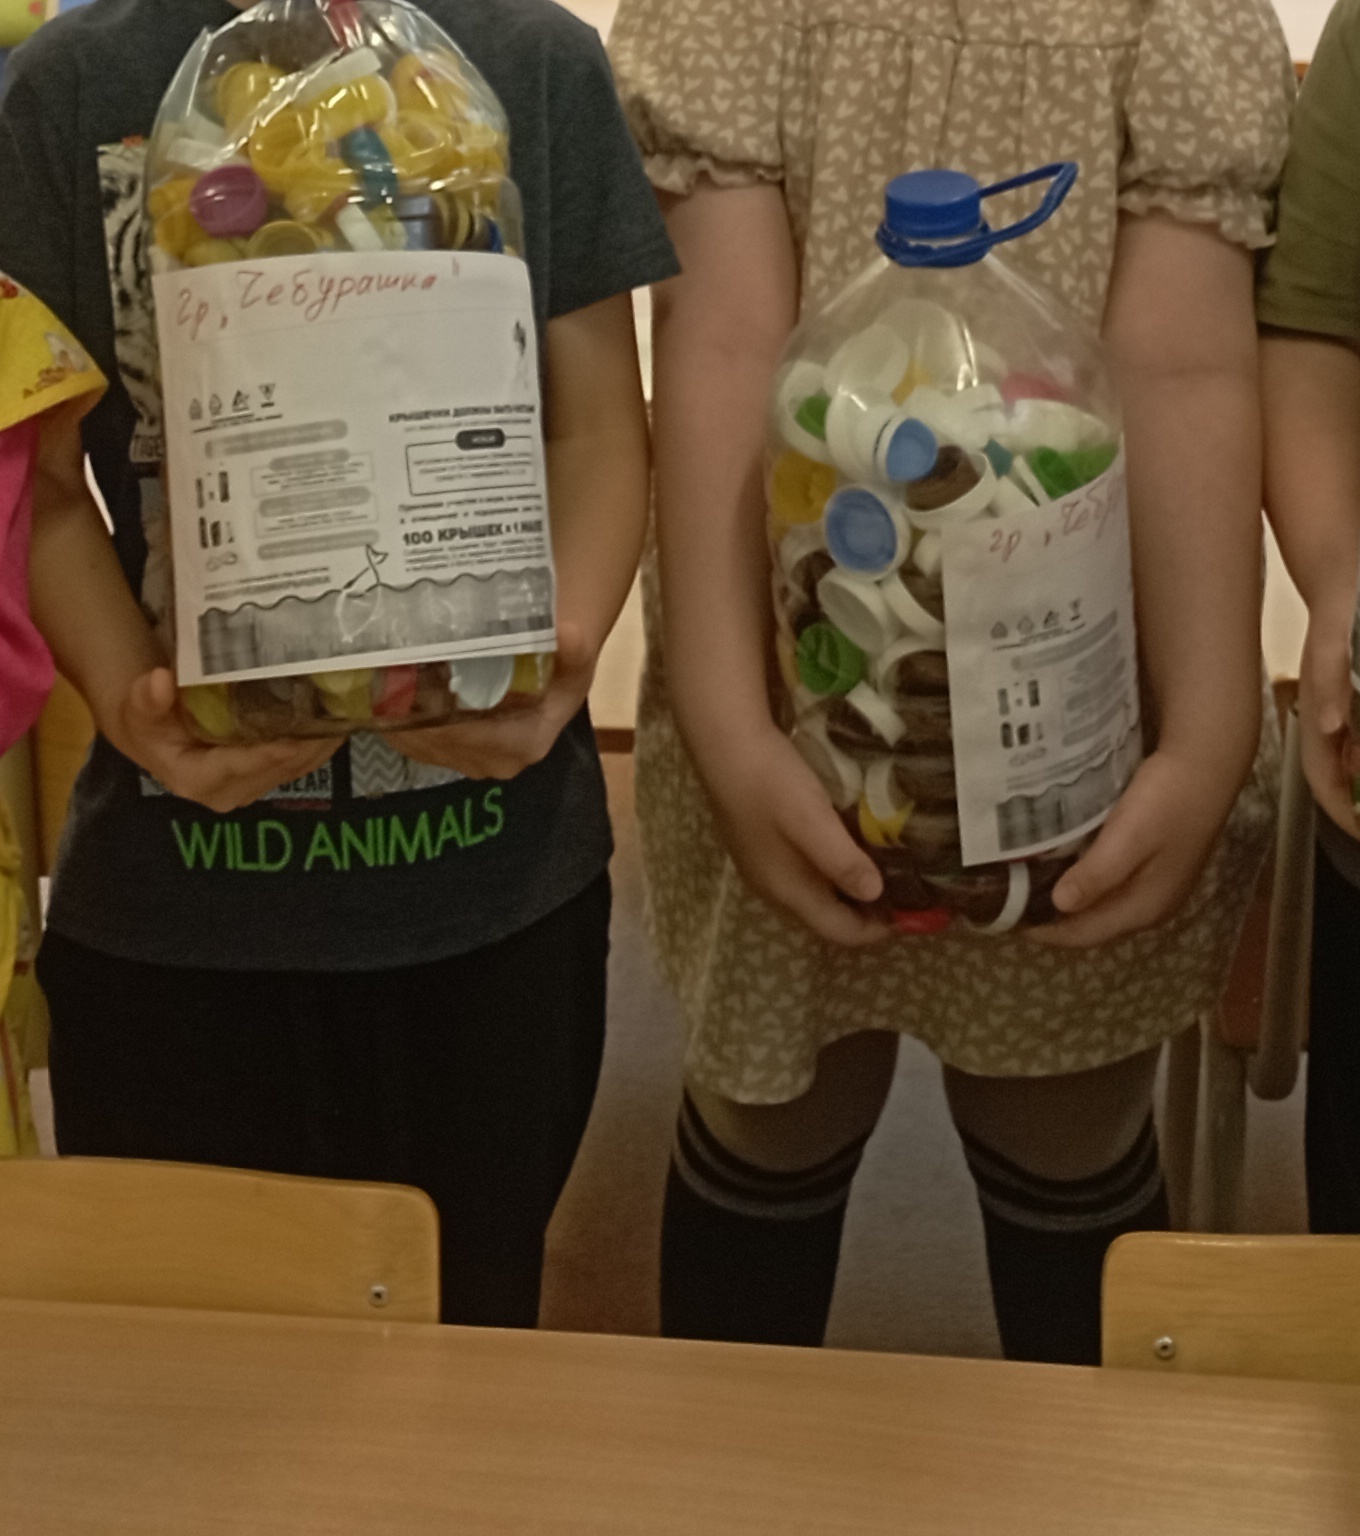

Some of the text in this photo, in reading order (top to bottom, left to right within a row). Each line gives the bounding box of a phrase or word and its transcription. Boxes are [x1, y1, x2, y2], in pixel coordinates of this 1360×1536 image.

[403, 529, 433, 546] 100
[171, 786, 505, 873] WILD ANIMALS
